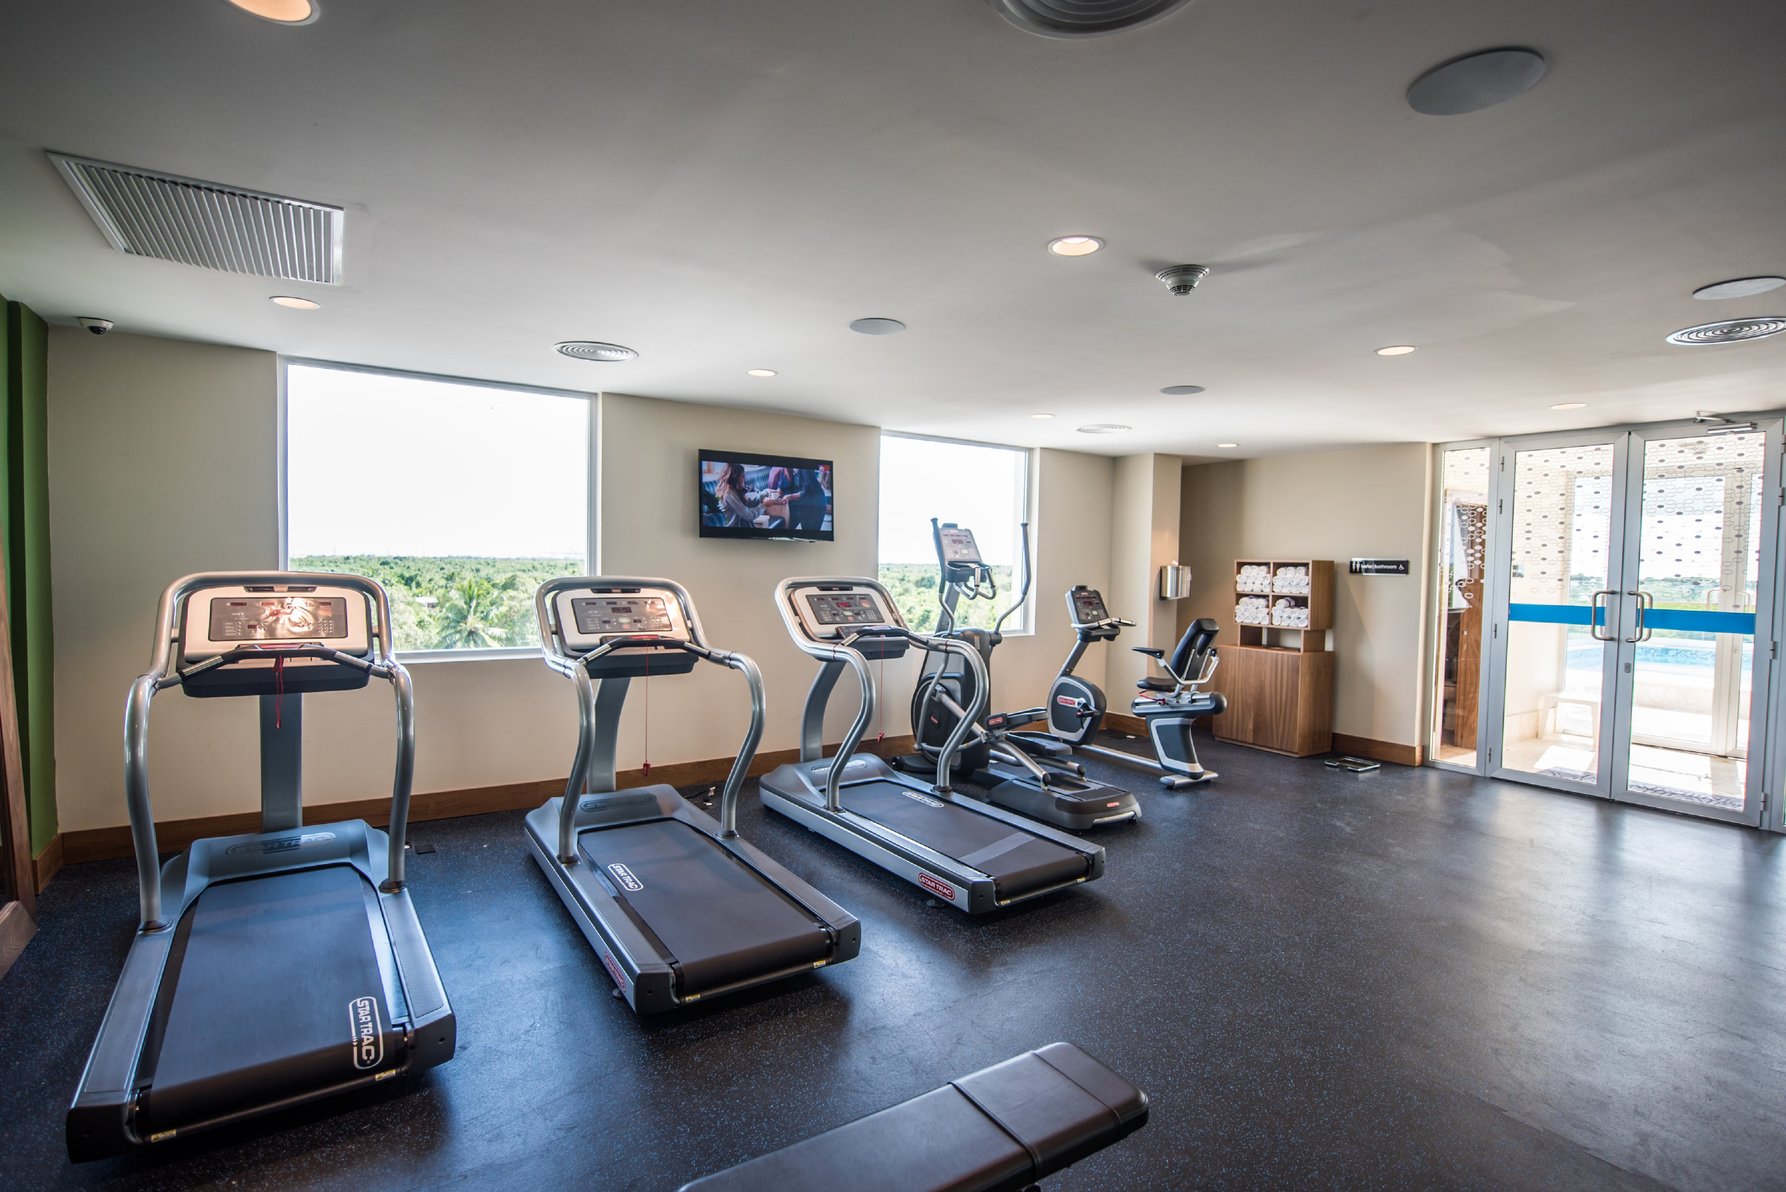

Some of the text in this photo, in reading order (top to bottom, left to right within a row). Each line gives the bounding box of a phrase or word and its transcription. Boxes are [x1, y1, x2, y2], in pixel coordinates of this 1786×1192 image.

[622, 876, 638, 889] TRAC
[920, 876, 952, 896] STAR TRAC
[356, 998, 376, 1060] STAR TRAC
